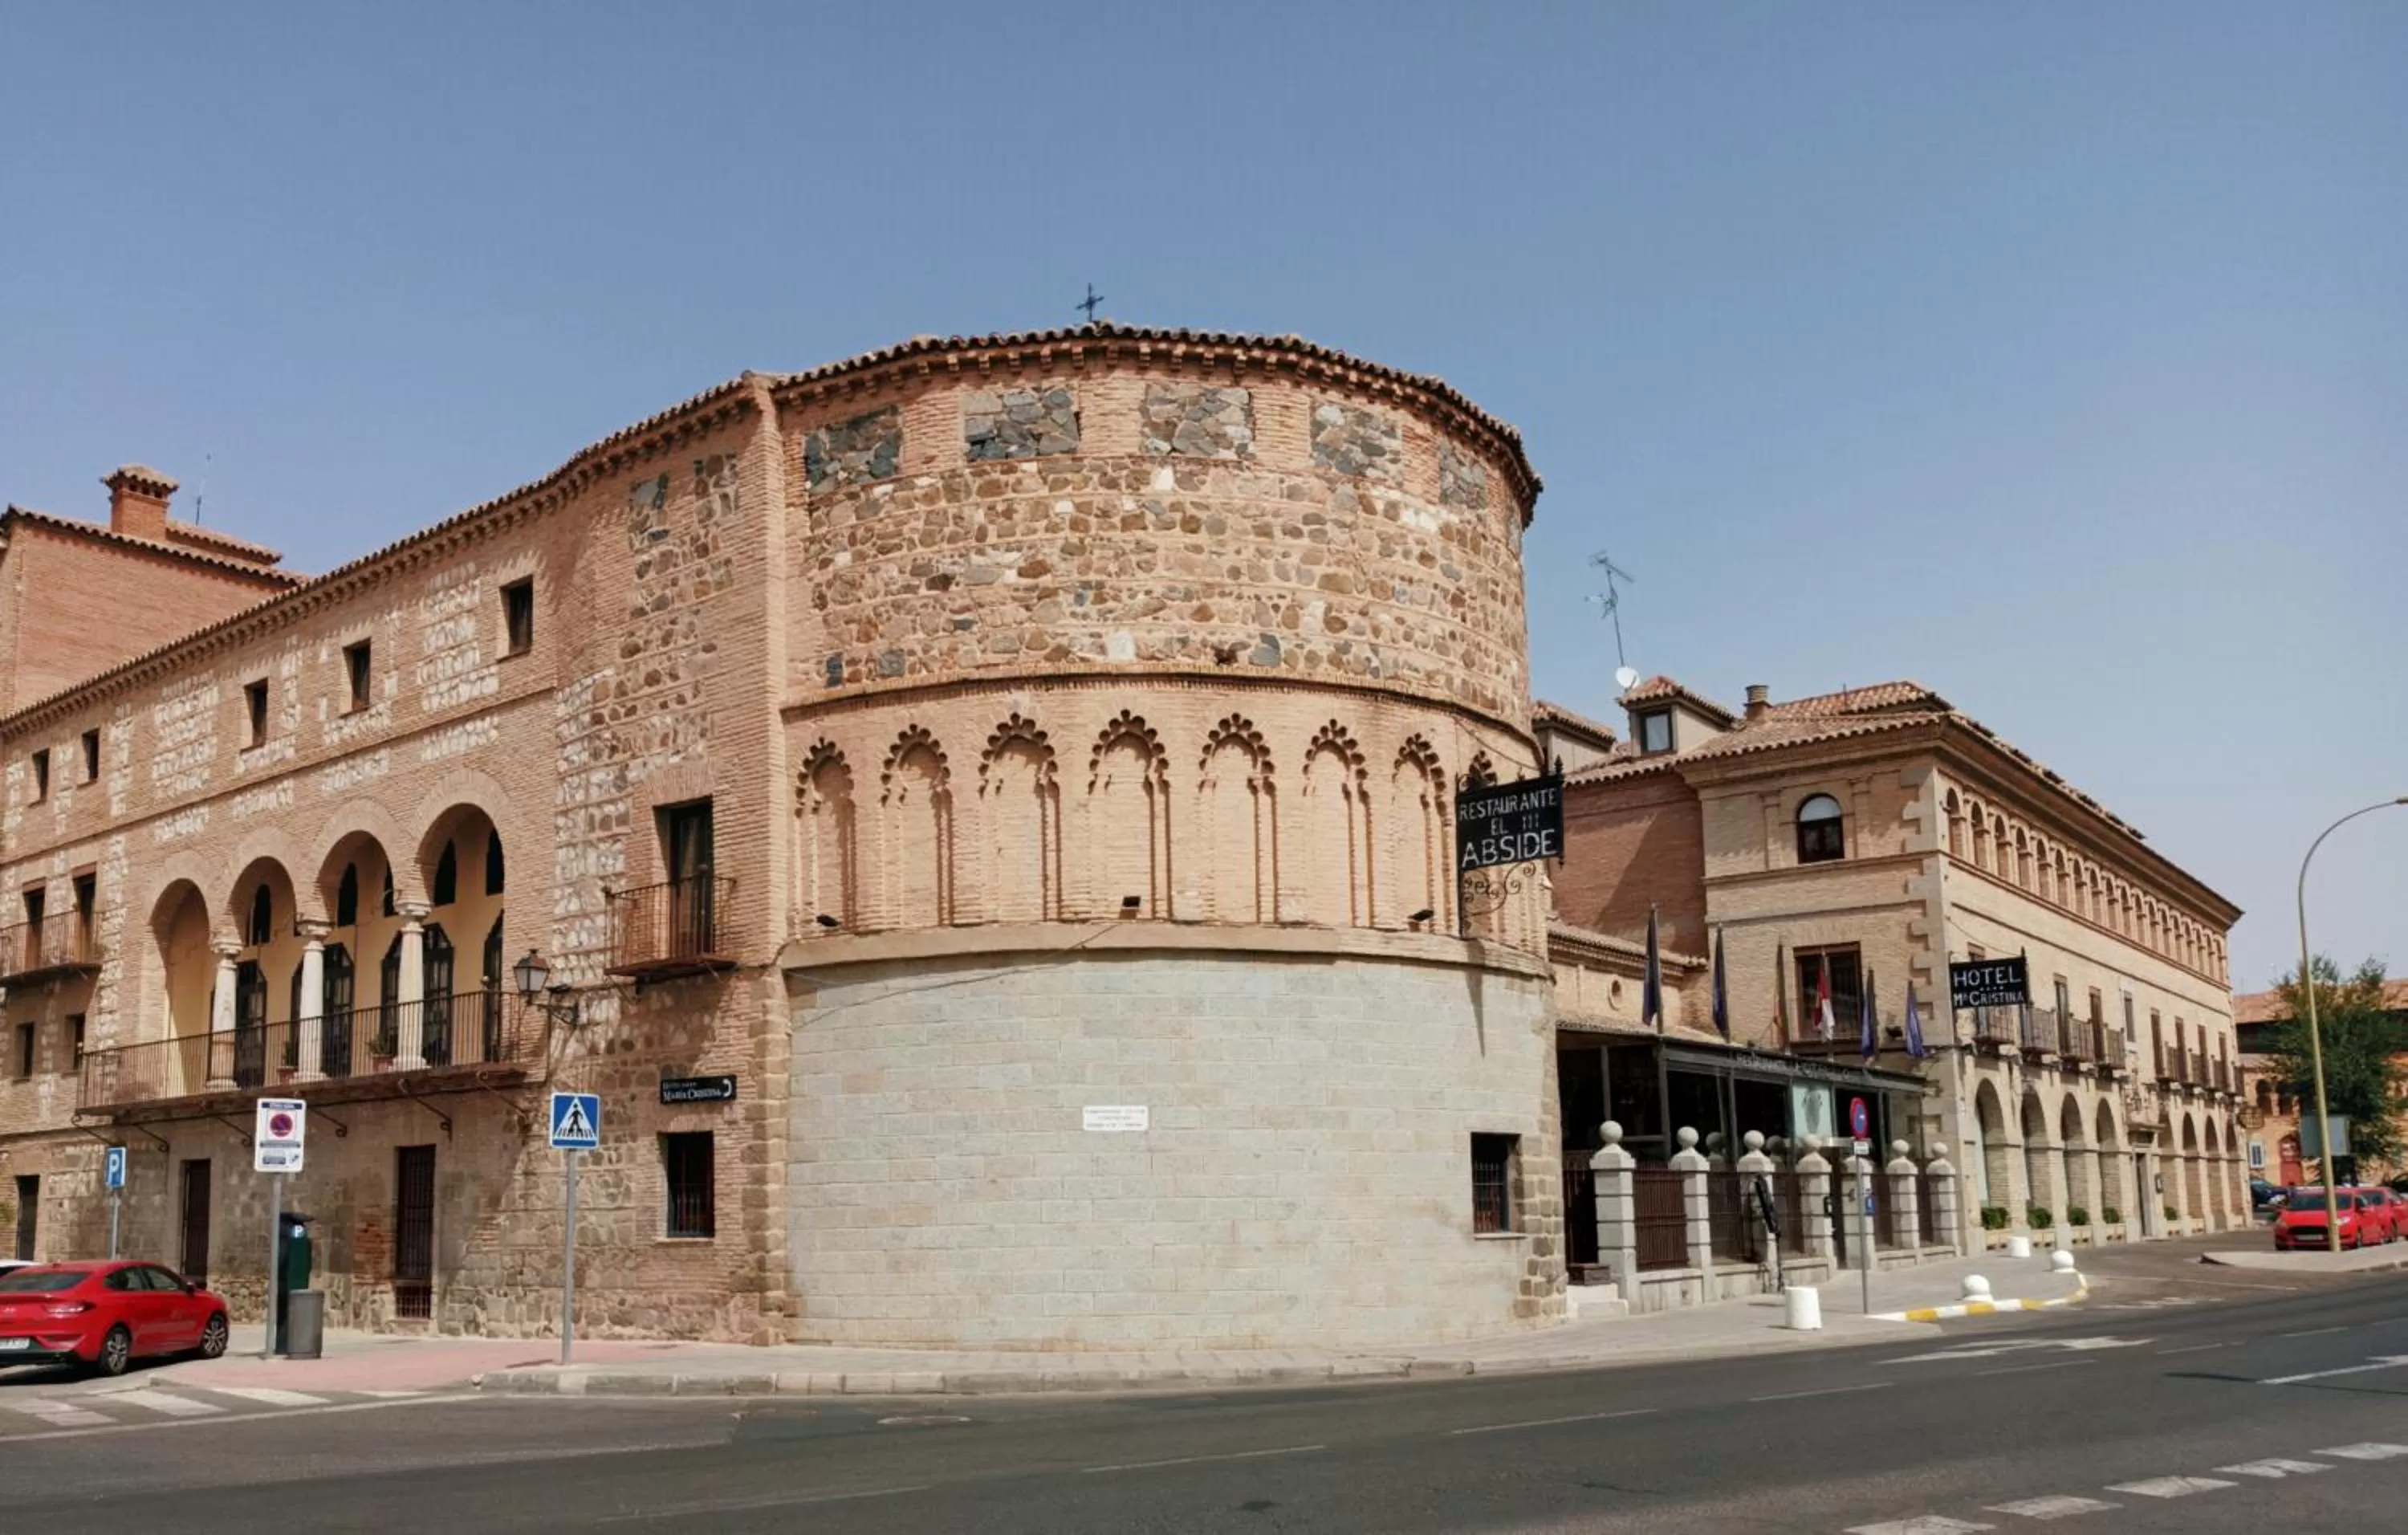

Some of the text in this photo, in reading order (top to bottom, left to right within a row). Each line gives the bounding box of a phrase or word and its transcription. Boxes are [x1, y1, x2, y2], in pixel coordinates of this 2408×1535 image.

[1459, 788, 1556, 820] RESTAURANTE
[1491, 816, 1509, 835] EL
[1461, 829, 1557, 867] ABSIDE
[1953, 966, 2022, 987] HOTEL
[108, 1153, 120, 1184] P
[295, 1224, 303, 1237] P
